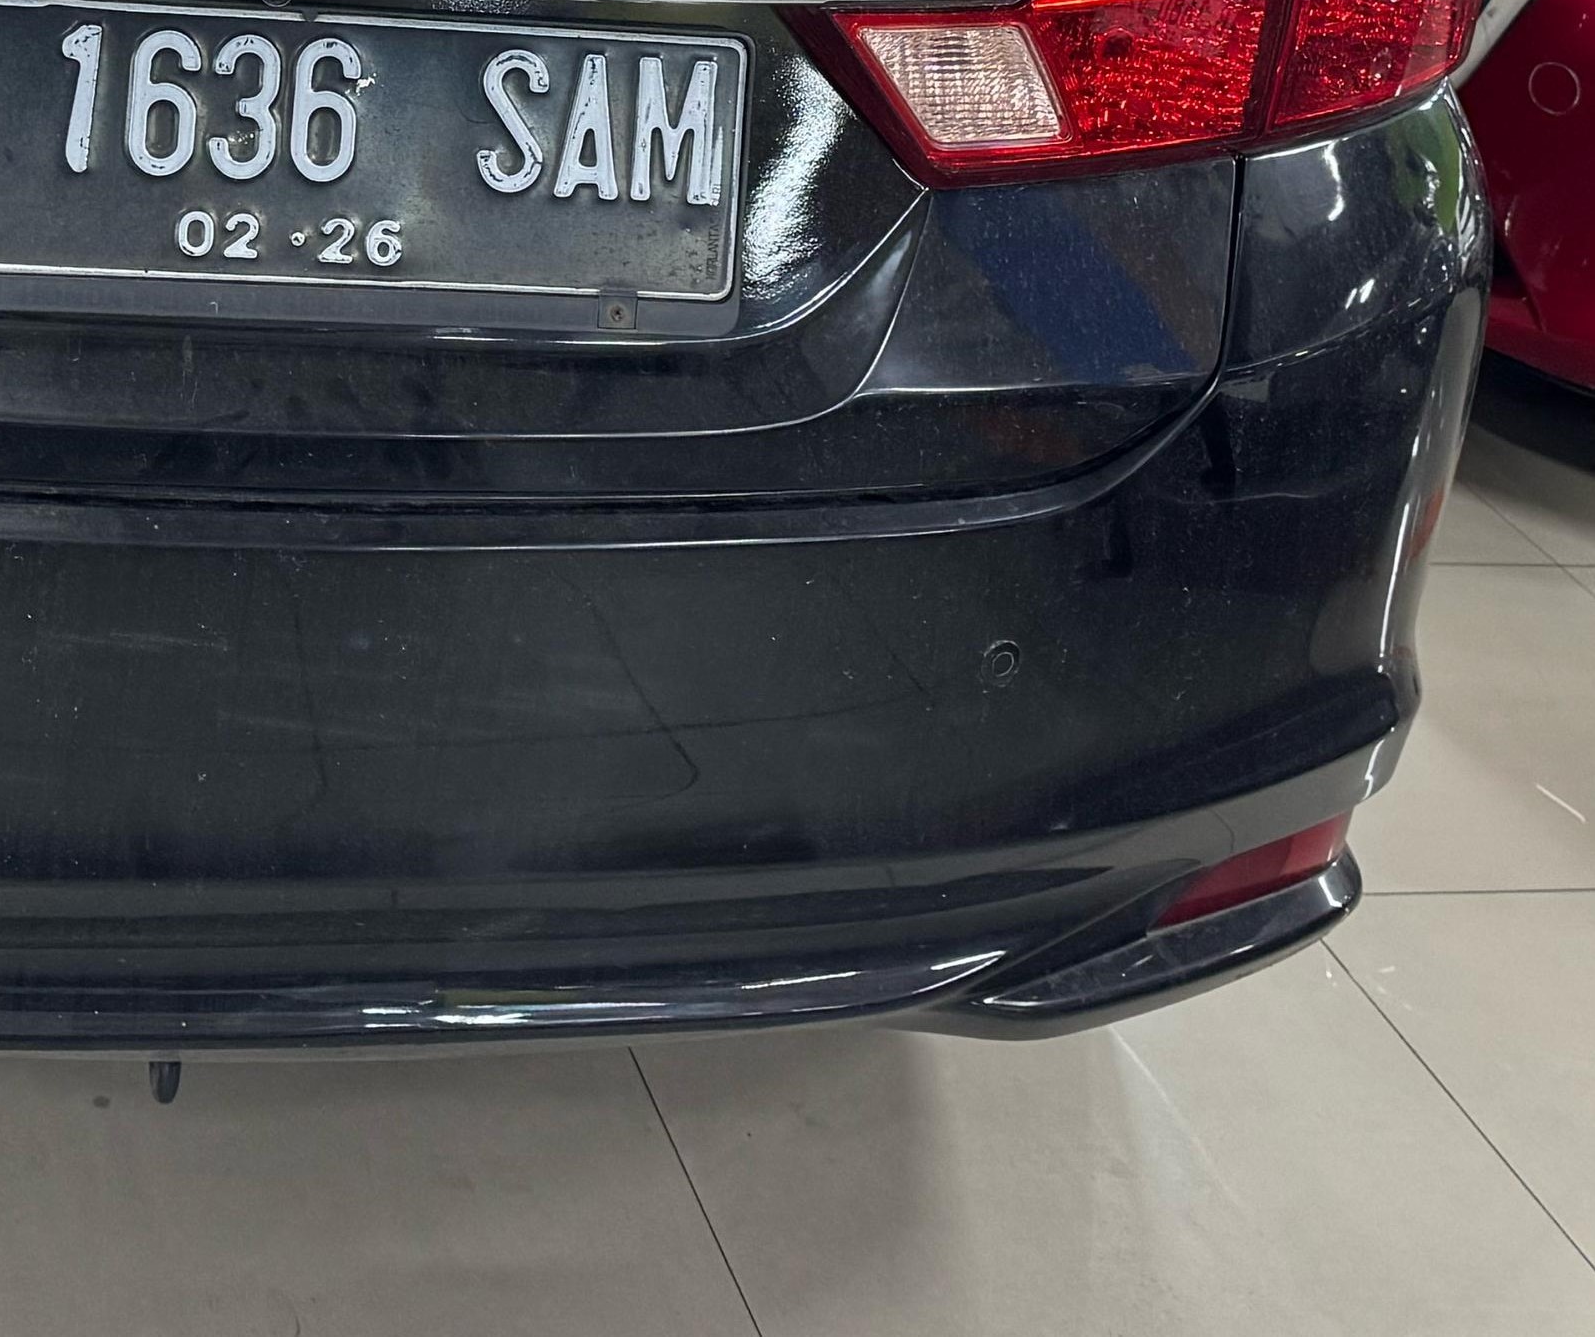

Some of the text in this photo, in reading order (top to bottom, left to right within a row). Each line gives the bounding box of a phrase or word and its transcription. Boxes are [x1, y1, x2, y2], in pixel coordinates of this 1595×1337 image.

[62, 24, 362, 183] 1636
[476, 49, 719, 206] SAM
[177, 210, 260, 257] 02
